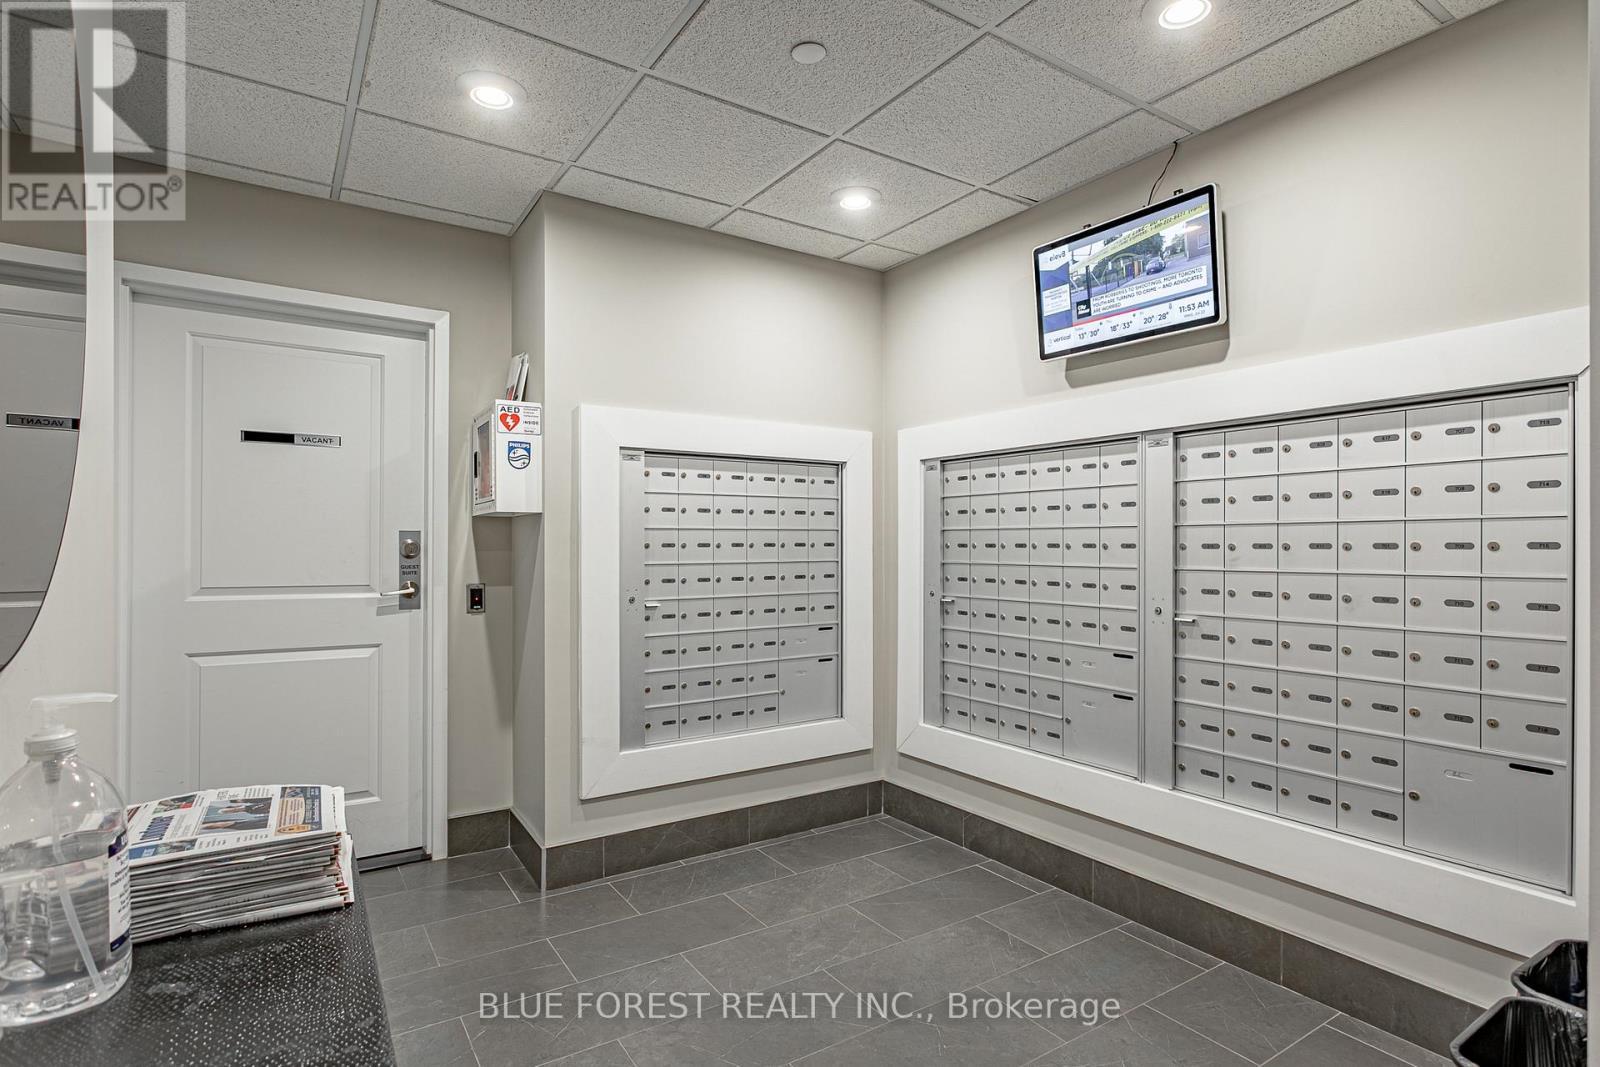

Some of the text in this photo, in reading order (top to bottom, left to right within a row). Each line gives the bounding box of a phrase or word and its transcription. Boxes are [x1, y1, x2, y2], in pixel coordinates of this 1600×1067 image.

[1178, 267, 1203, 279] TORONTO
[1179, 299, 1210, 313] 11:53 AM
[301, 436, 334, 445] VACANT
